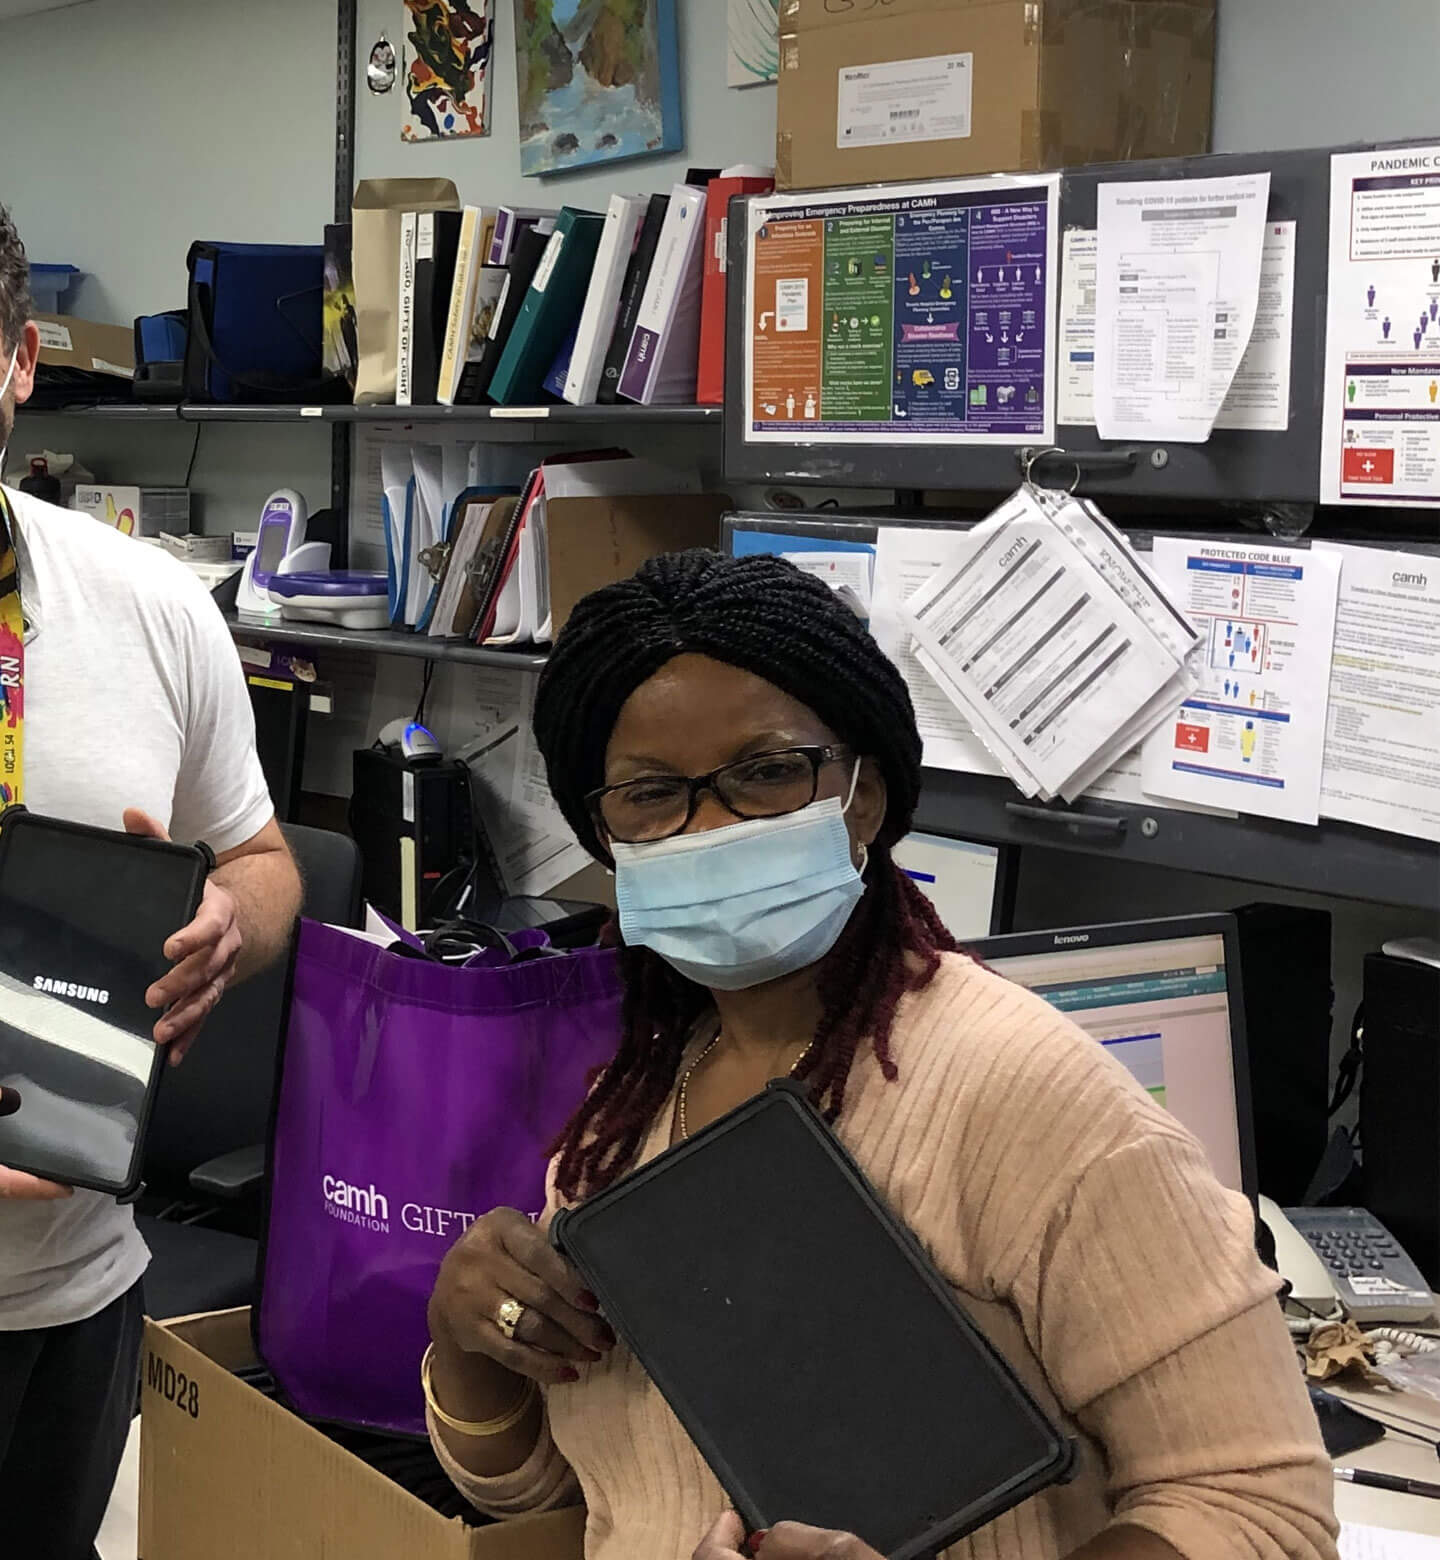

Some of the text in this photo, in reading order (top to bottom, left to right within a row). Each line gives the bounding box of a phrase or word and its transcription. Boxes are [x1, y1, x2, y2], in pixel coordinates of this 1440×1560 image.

[1371, 157, 1430, 171] PANDEMIC
[806, 206, 846, 217] Emergency
[848, 202, 900, 215] Preparedness
[911, 198, 937, 208] CAMH
[975, 211, 982, 220] 4
[827, 222, 834, 232] 2
[898, 217, 905, 226] 3
[402, 296, 410, 332] GIFTS
[401, 336, 409, 350] OF
[637, 333, 650, 362] camh
[400, 358, 408, 395] LIGHT
[1375, 412, 1403, 420] Personal
[999, 536, 1028, 567] camh
[1201, 548, 1291, 564] PROTECTED CODE BLUE
[1392, 572, 1427, 586] camh
[0, 655, 20, 688] RN
[4, 734, 15, 774] LOCAL 54
[1054, 934, 1089, 945] lenovo
[33, 976, 109, 1004] SAMSUNG
[323, 1175, 388, 1219] camh
[324, 1200, 390, 1234] FOUNDATION
[148, 1352, 199, 1419] MD28
